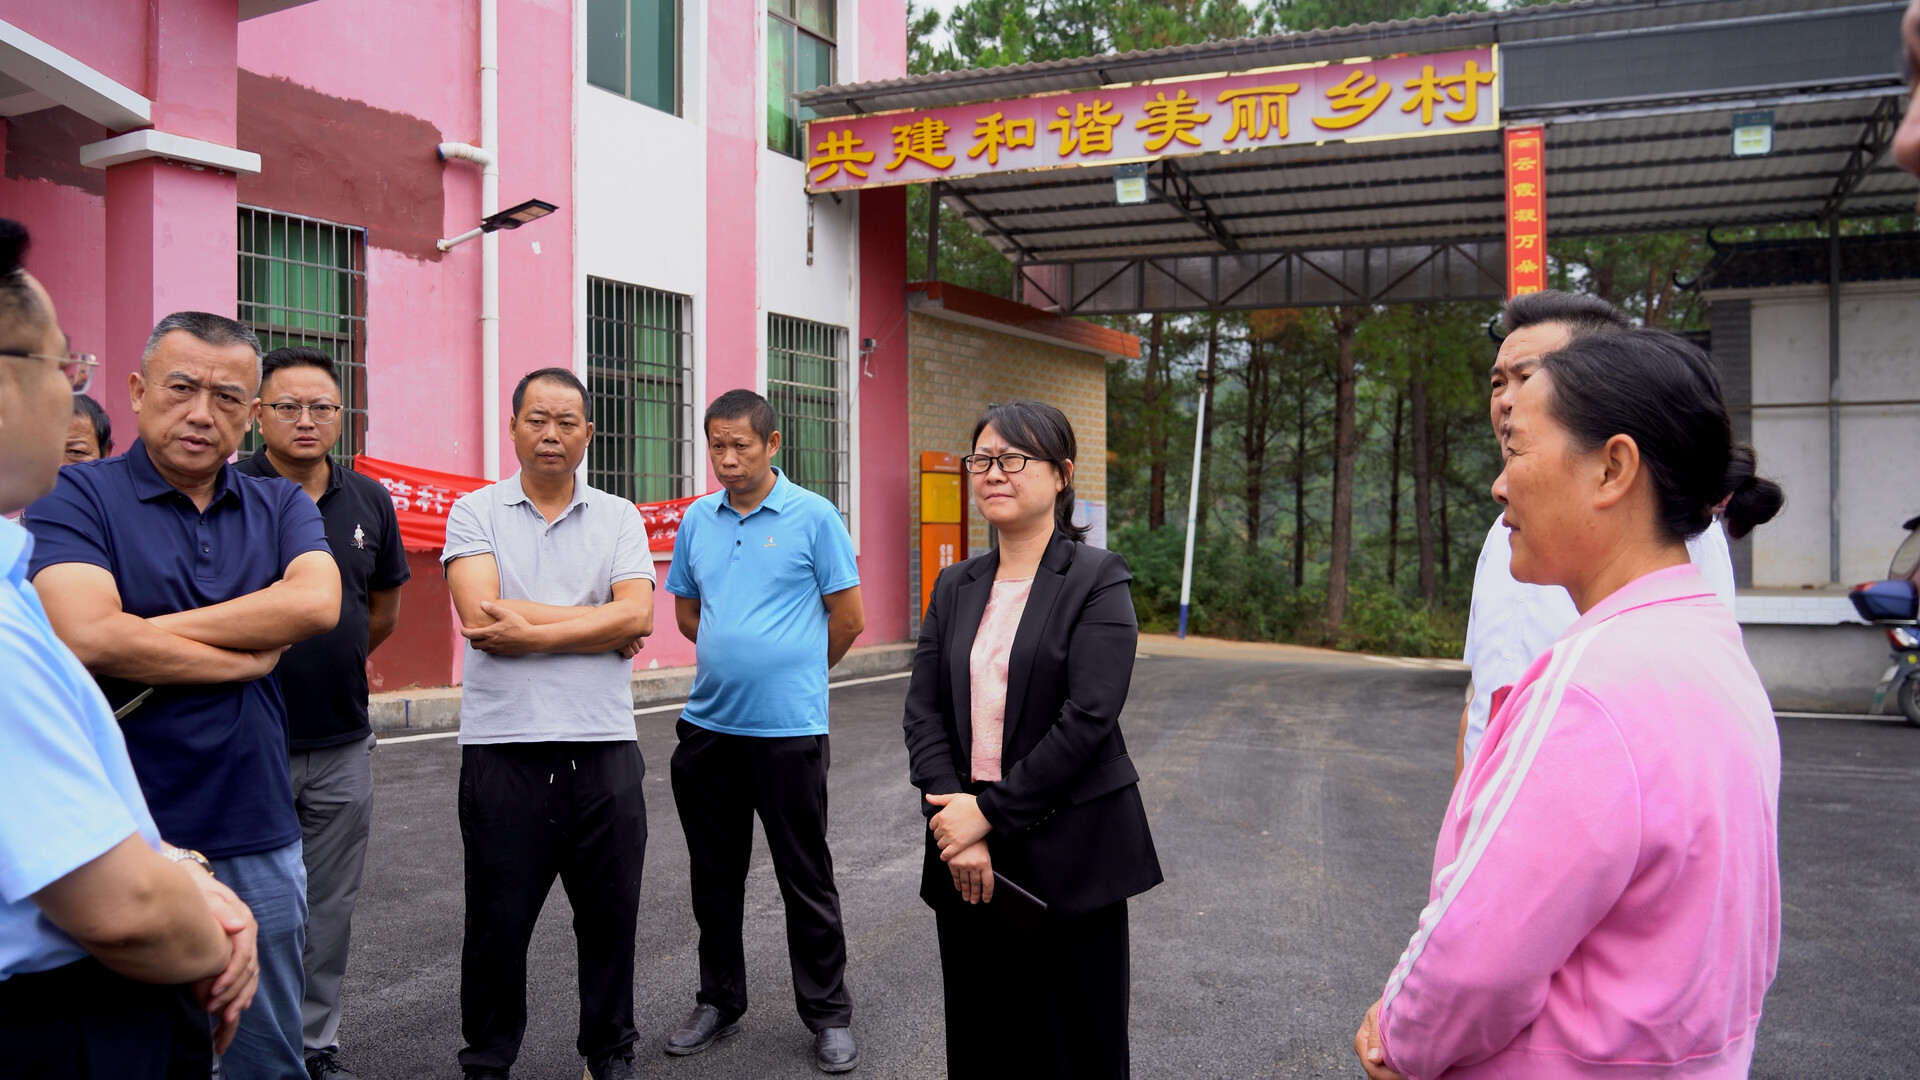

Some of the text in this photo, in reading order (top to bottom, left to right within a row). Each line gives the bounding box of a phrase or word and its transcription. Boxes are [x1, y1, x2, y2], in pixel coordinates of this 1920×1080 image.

[809, 60, 1496, 183] 共建和谐美丽乡村
